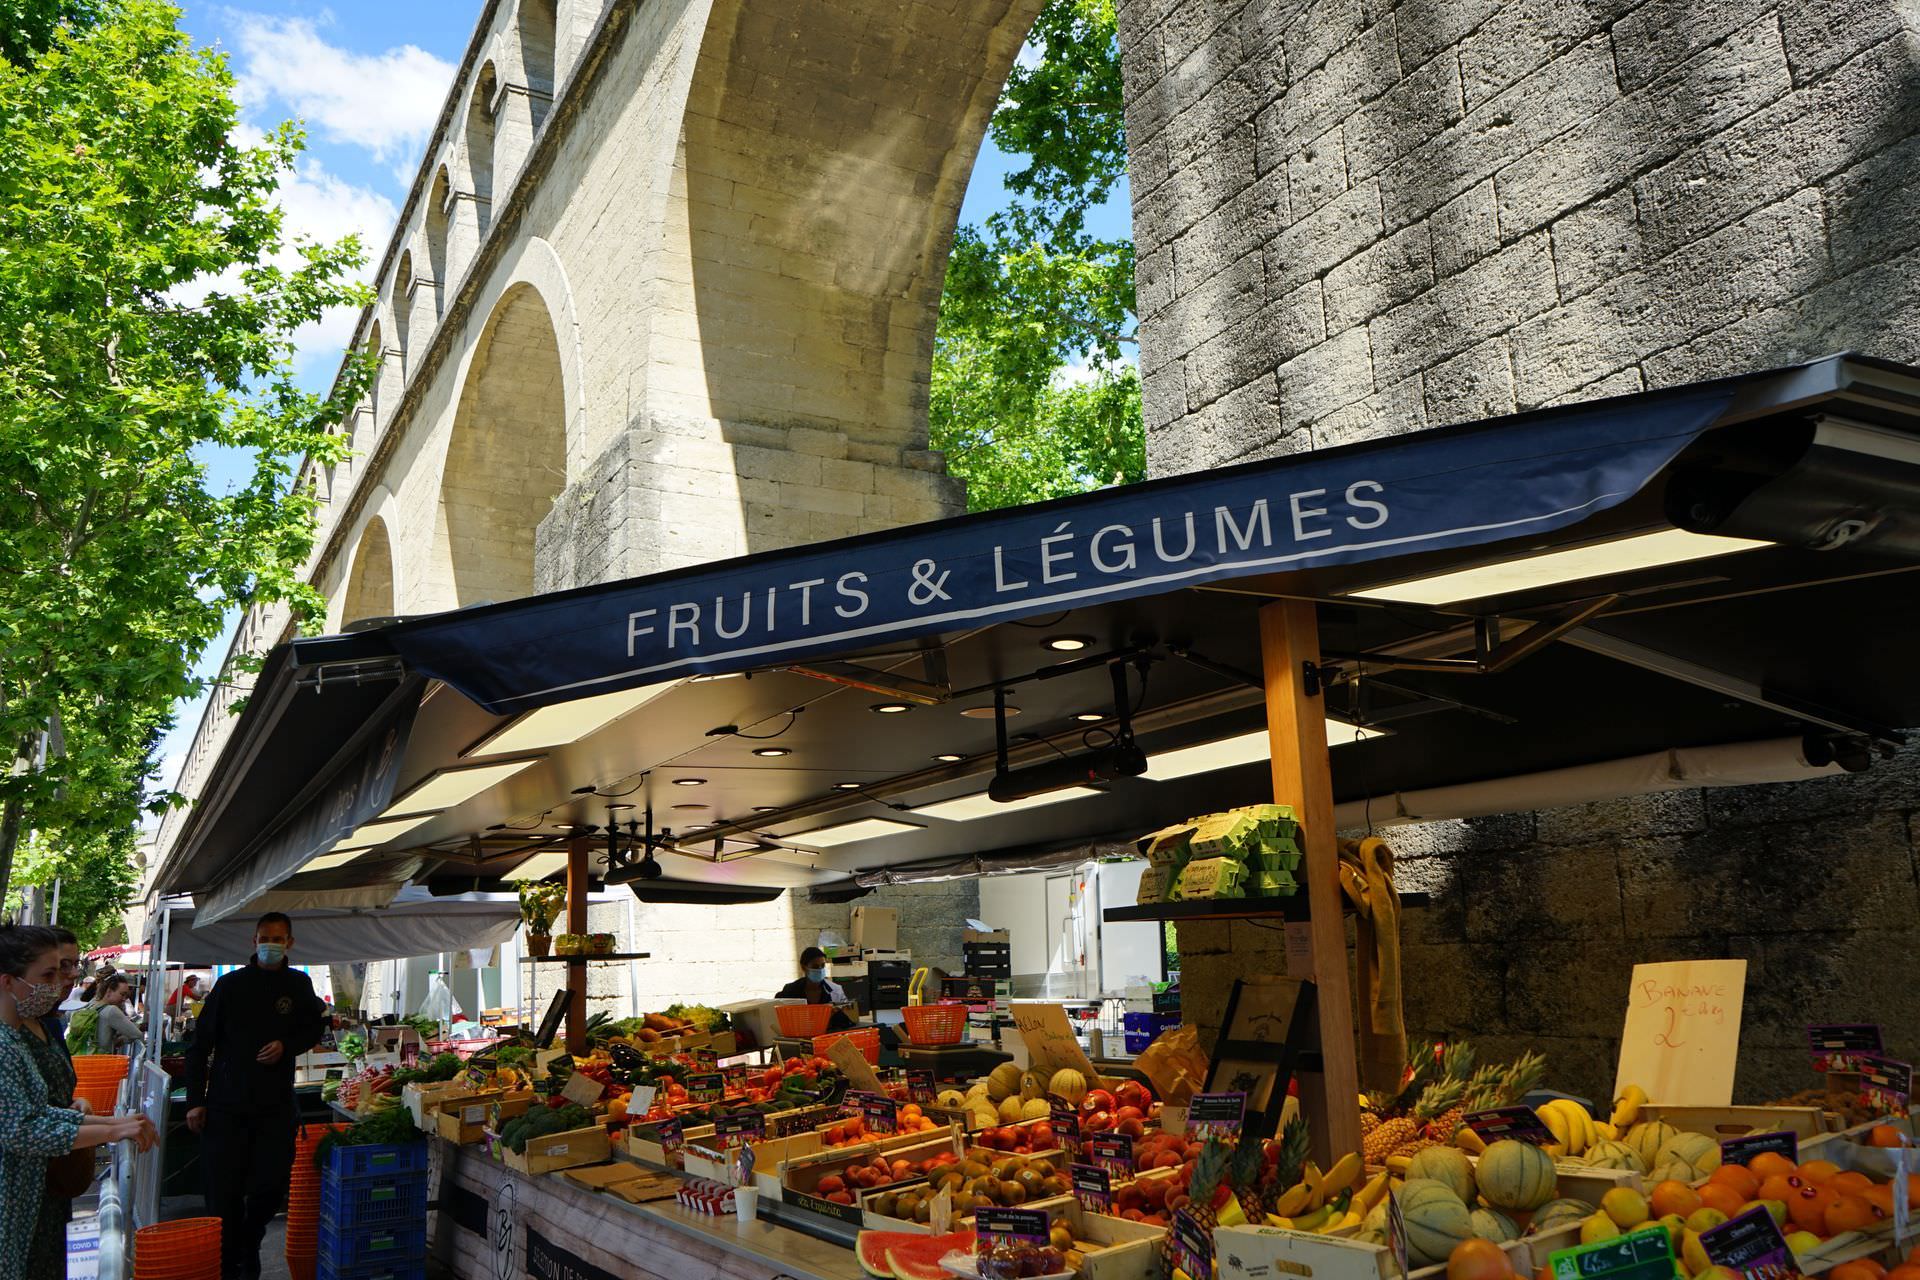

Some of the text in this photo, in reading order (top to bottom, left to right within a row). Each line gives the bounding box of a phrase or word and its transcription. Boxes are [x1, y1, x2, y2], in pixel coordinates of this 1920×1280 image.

[627, 480, 1389, 657] FRUITS & LÉGUMES
[1655, 1007, 1686, 1048] 2
